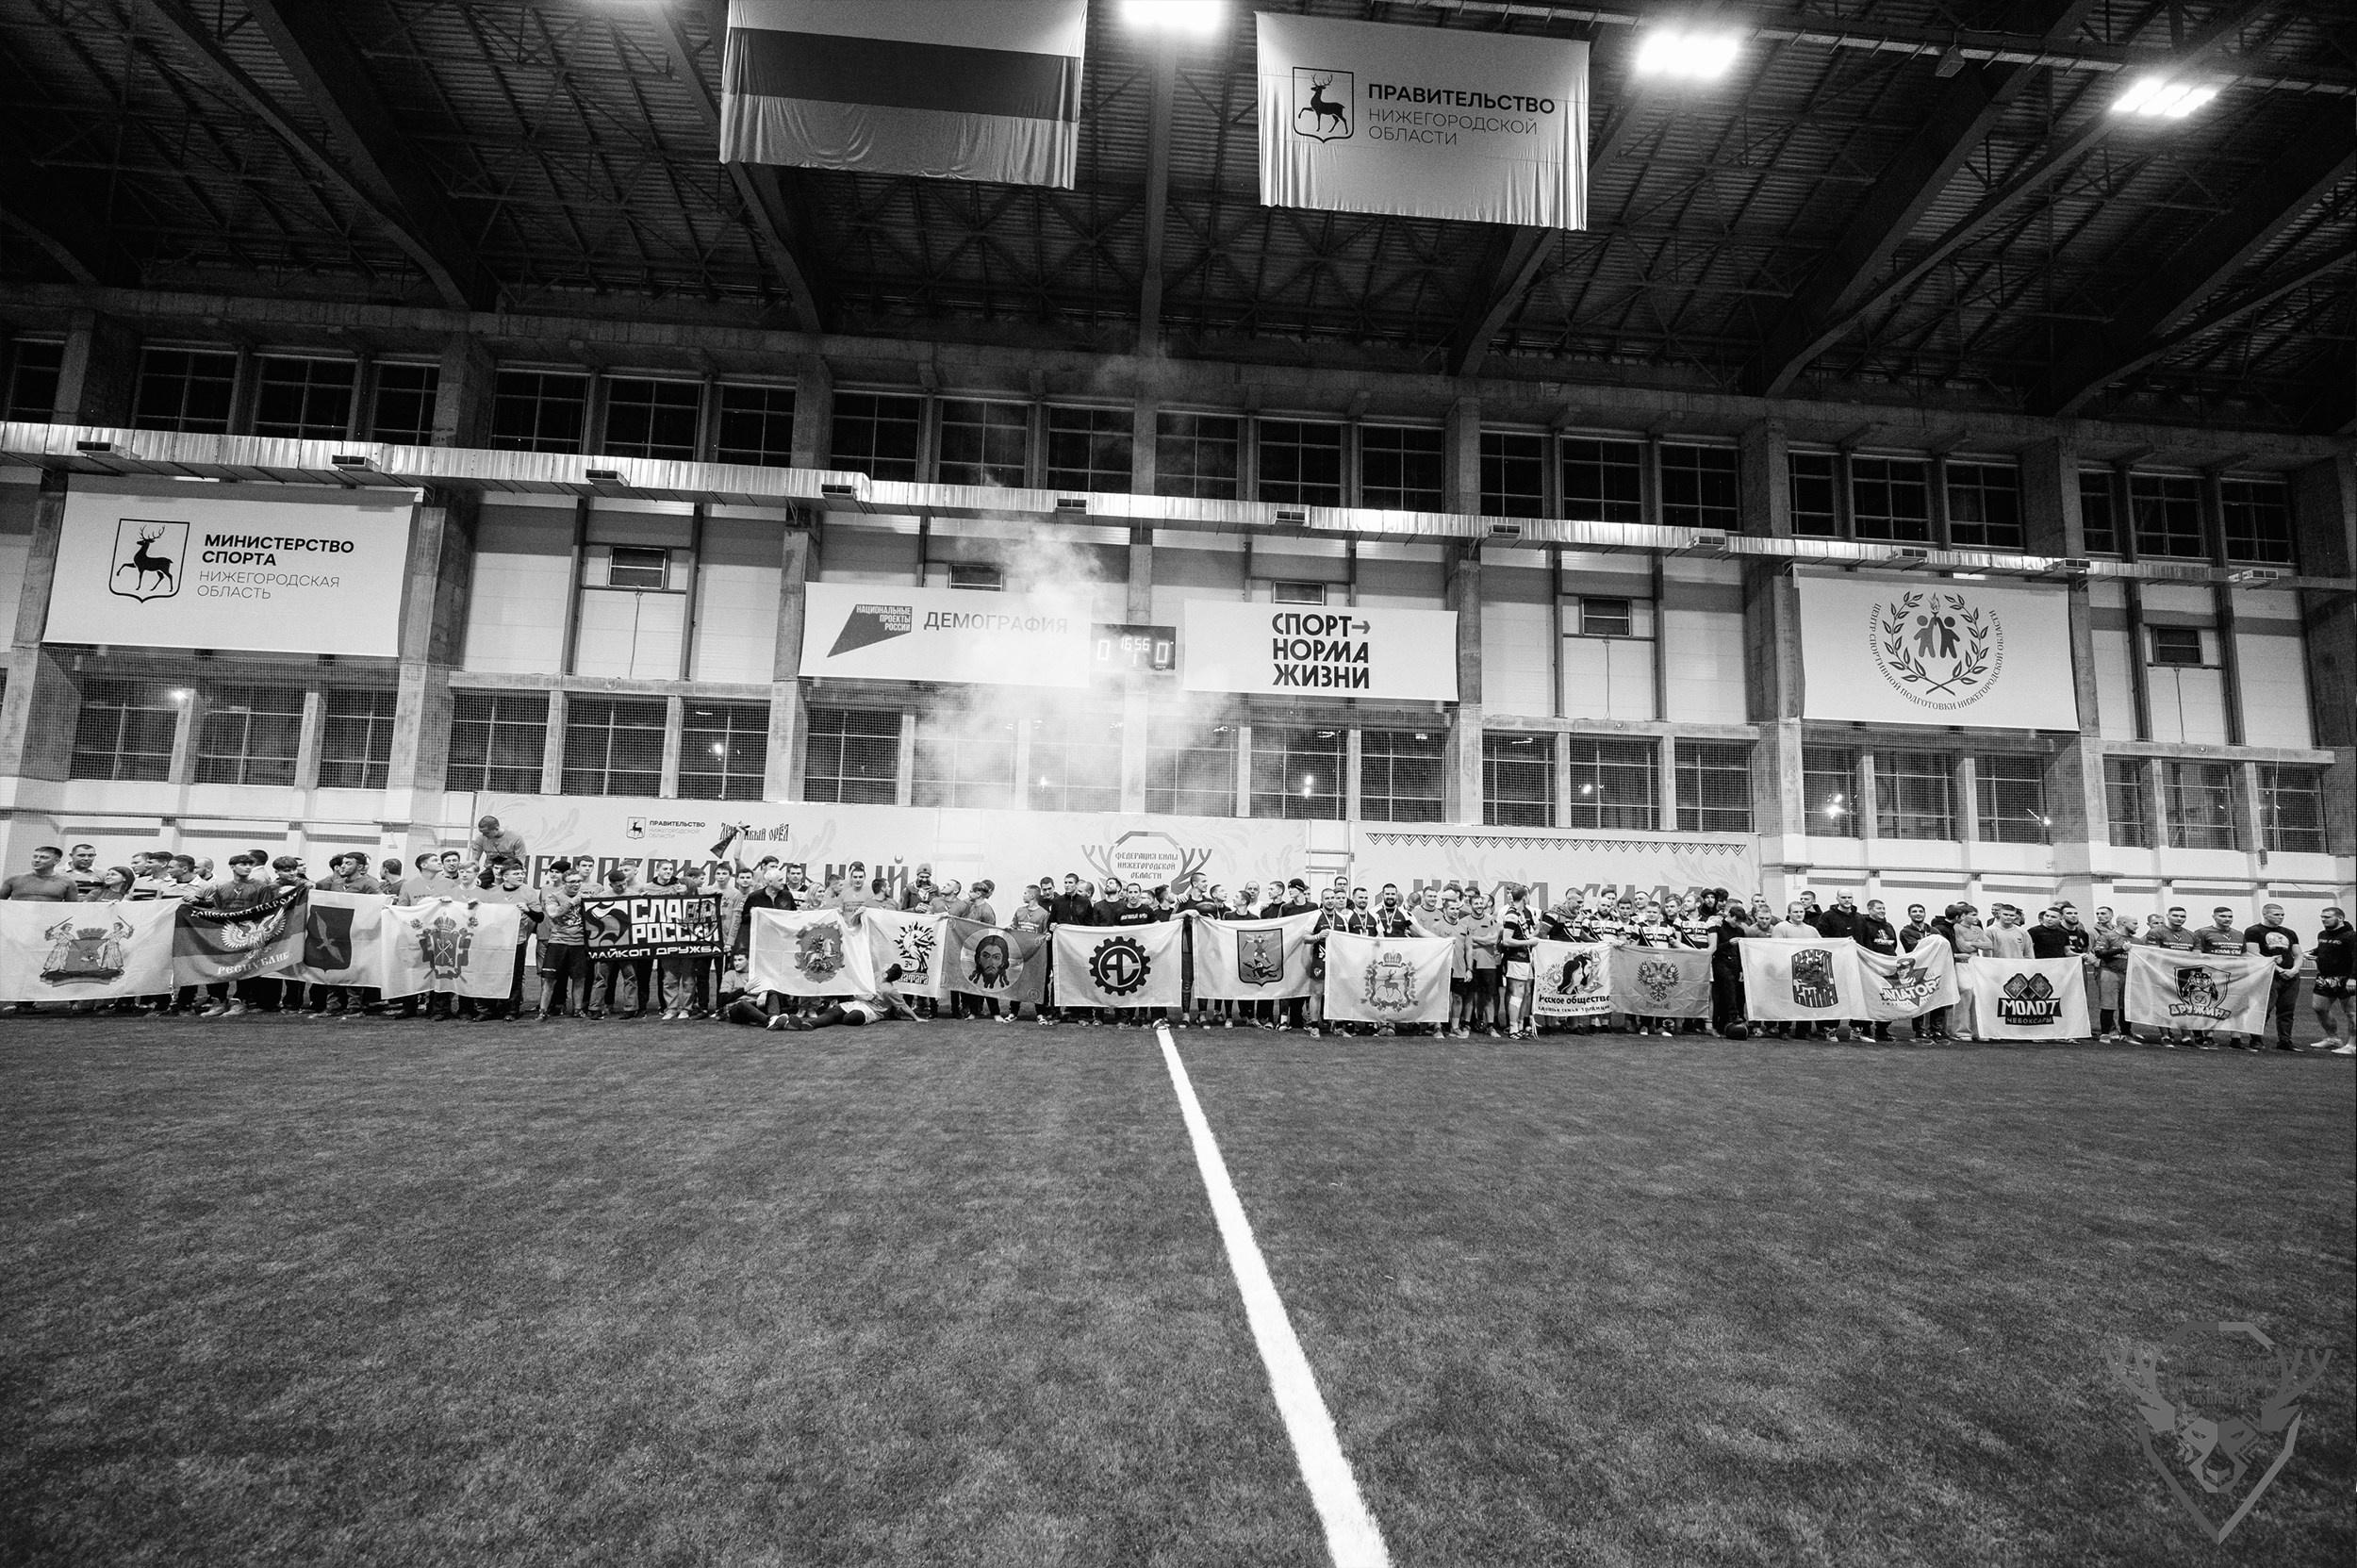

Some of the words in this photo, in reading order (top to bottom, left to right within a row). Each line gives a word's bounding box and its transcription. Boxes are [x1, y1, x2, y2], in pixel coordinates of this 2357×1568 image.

[1368, 83, 1556, 114] ПРАВИТЕЛЬСТВО
[1369, 108, 1538, 135] НИЖЕГОРОДСКОЙ
[1368, 125, 1457, 145] ОБЛАСТИ
[205, 534, 354, 553] МИНИСТЕРСТВО
[202, 551, 277, 566] СПОРТА
[199, 570, 340, 587] НИЖЕГОРОДСКАЯ
[197, 585, 272, 600] ОБЛАСТЬ
[856, 604, 912, 615] НАЦИОНАЛЬНЫЕ
[879, 615, 911, 623] ПРОЕКТЫ
[1870, 602, 1882, 633] ЦЕНТР
[884, 623, 911, 632] РОССИИ
[923, 611, 1068, 634] ДЕМОГРАФИЯ
[1272, 613, 1352, 637] СПОРТ
[1988, 609, 2004, 652] ОБЛАСТИ
[1156, 642, 1168, 663] 0
[1273, 638, 1369, 664] НОРМА
[1869, 634, 1902, 691] СПОРТИВНОЙ
[1272, 663, 1370, 689] ЖИЗНИ
[1957, 652, 2004, 709] НИЖЕГОРОДСКОЙ
[1900, 687, 1957, 711] ПОДГОТОВКИ
[1115, 852, 1157, 861] ФЕДЕРАЦИЯ
[1117, 862, 1176, 870] НИЖЕГОРОДСКОЙ
[1130, 871, 1162, 880] ОБЛАСТИ
[655, 945, 722, 956] ДРУЖБА
[904, 960, 913, 968] 34
[1880, 976, 1941, 1001] AVIATOR
[2001, 999, 2059, 1015] МОЛОТ
